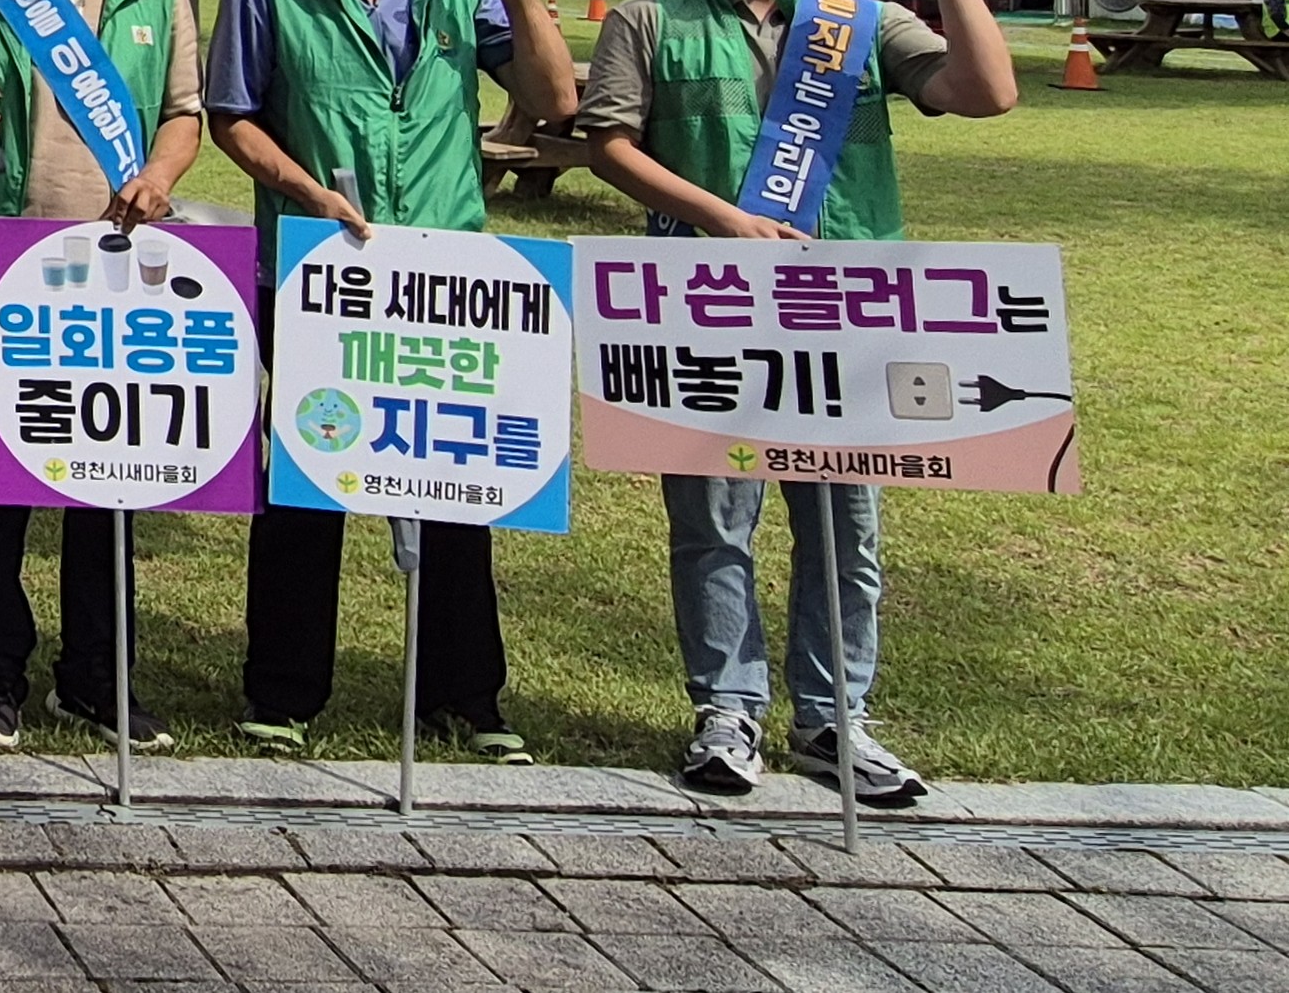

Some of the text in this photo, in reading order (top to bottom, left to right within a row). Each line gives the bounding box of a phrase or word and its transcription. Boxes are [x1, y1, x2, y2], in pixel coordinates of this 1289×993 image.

[795, 18, 852, 108] 지구는
[761, 113, 821, 212] 우리의
[301, 263, 551, 334] 다음 세대에게
[595, 262, 1050, 334] 다 쓴 플러그는
[339, 330, 501, 394] 깨끗한
[600, 344, 842, 417] 빼놓기!
[16, 380, 210, 449] 줄이기
[371, 397, 542, 469] 지구를
[70, 461, 197, 484] 영천시새마을회
[363, 474, 503, 505] 영천시새마을회
[766, 448, 952, 479] 영천시새마을회
